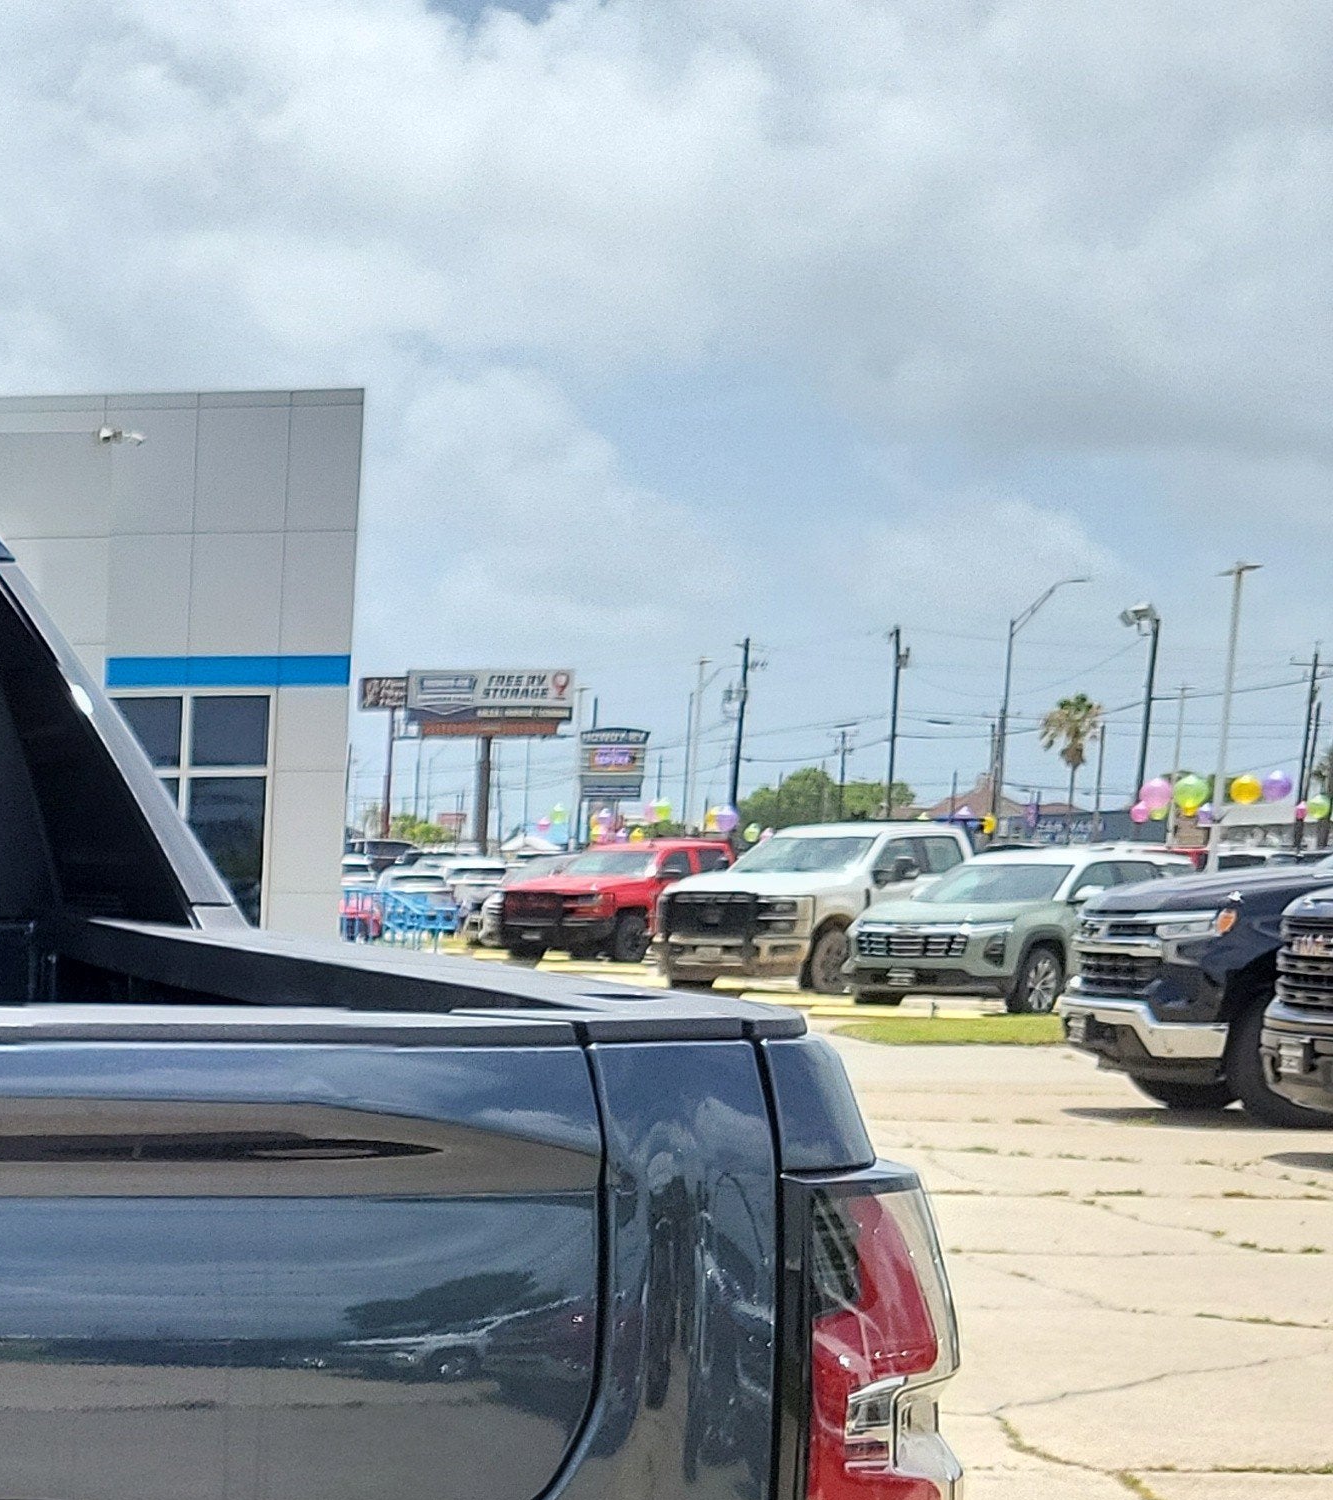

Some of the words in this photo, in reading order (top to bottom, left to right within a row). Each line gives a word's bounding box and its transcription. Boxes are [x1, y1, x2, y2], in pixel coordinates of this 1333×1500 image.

[487, 674, 524, 687] FREE
[526, 674, 547, 687] RV
[482, 687, 549, 700] STORAGE
